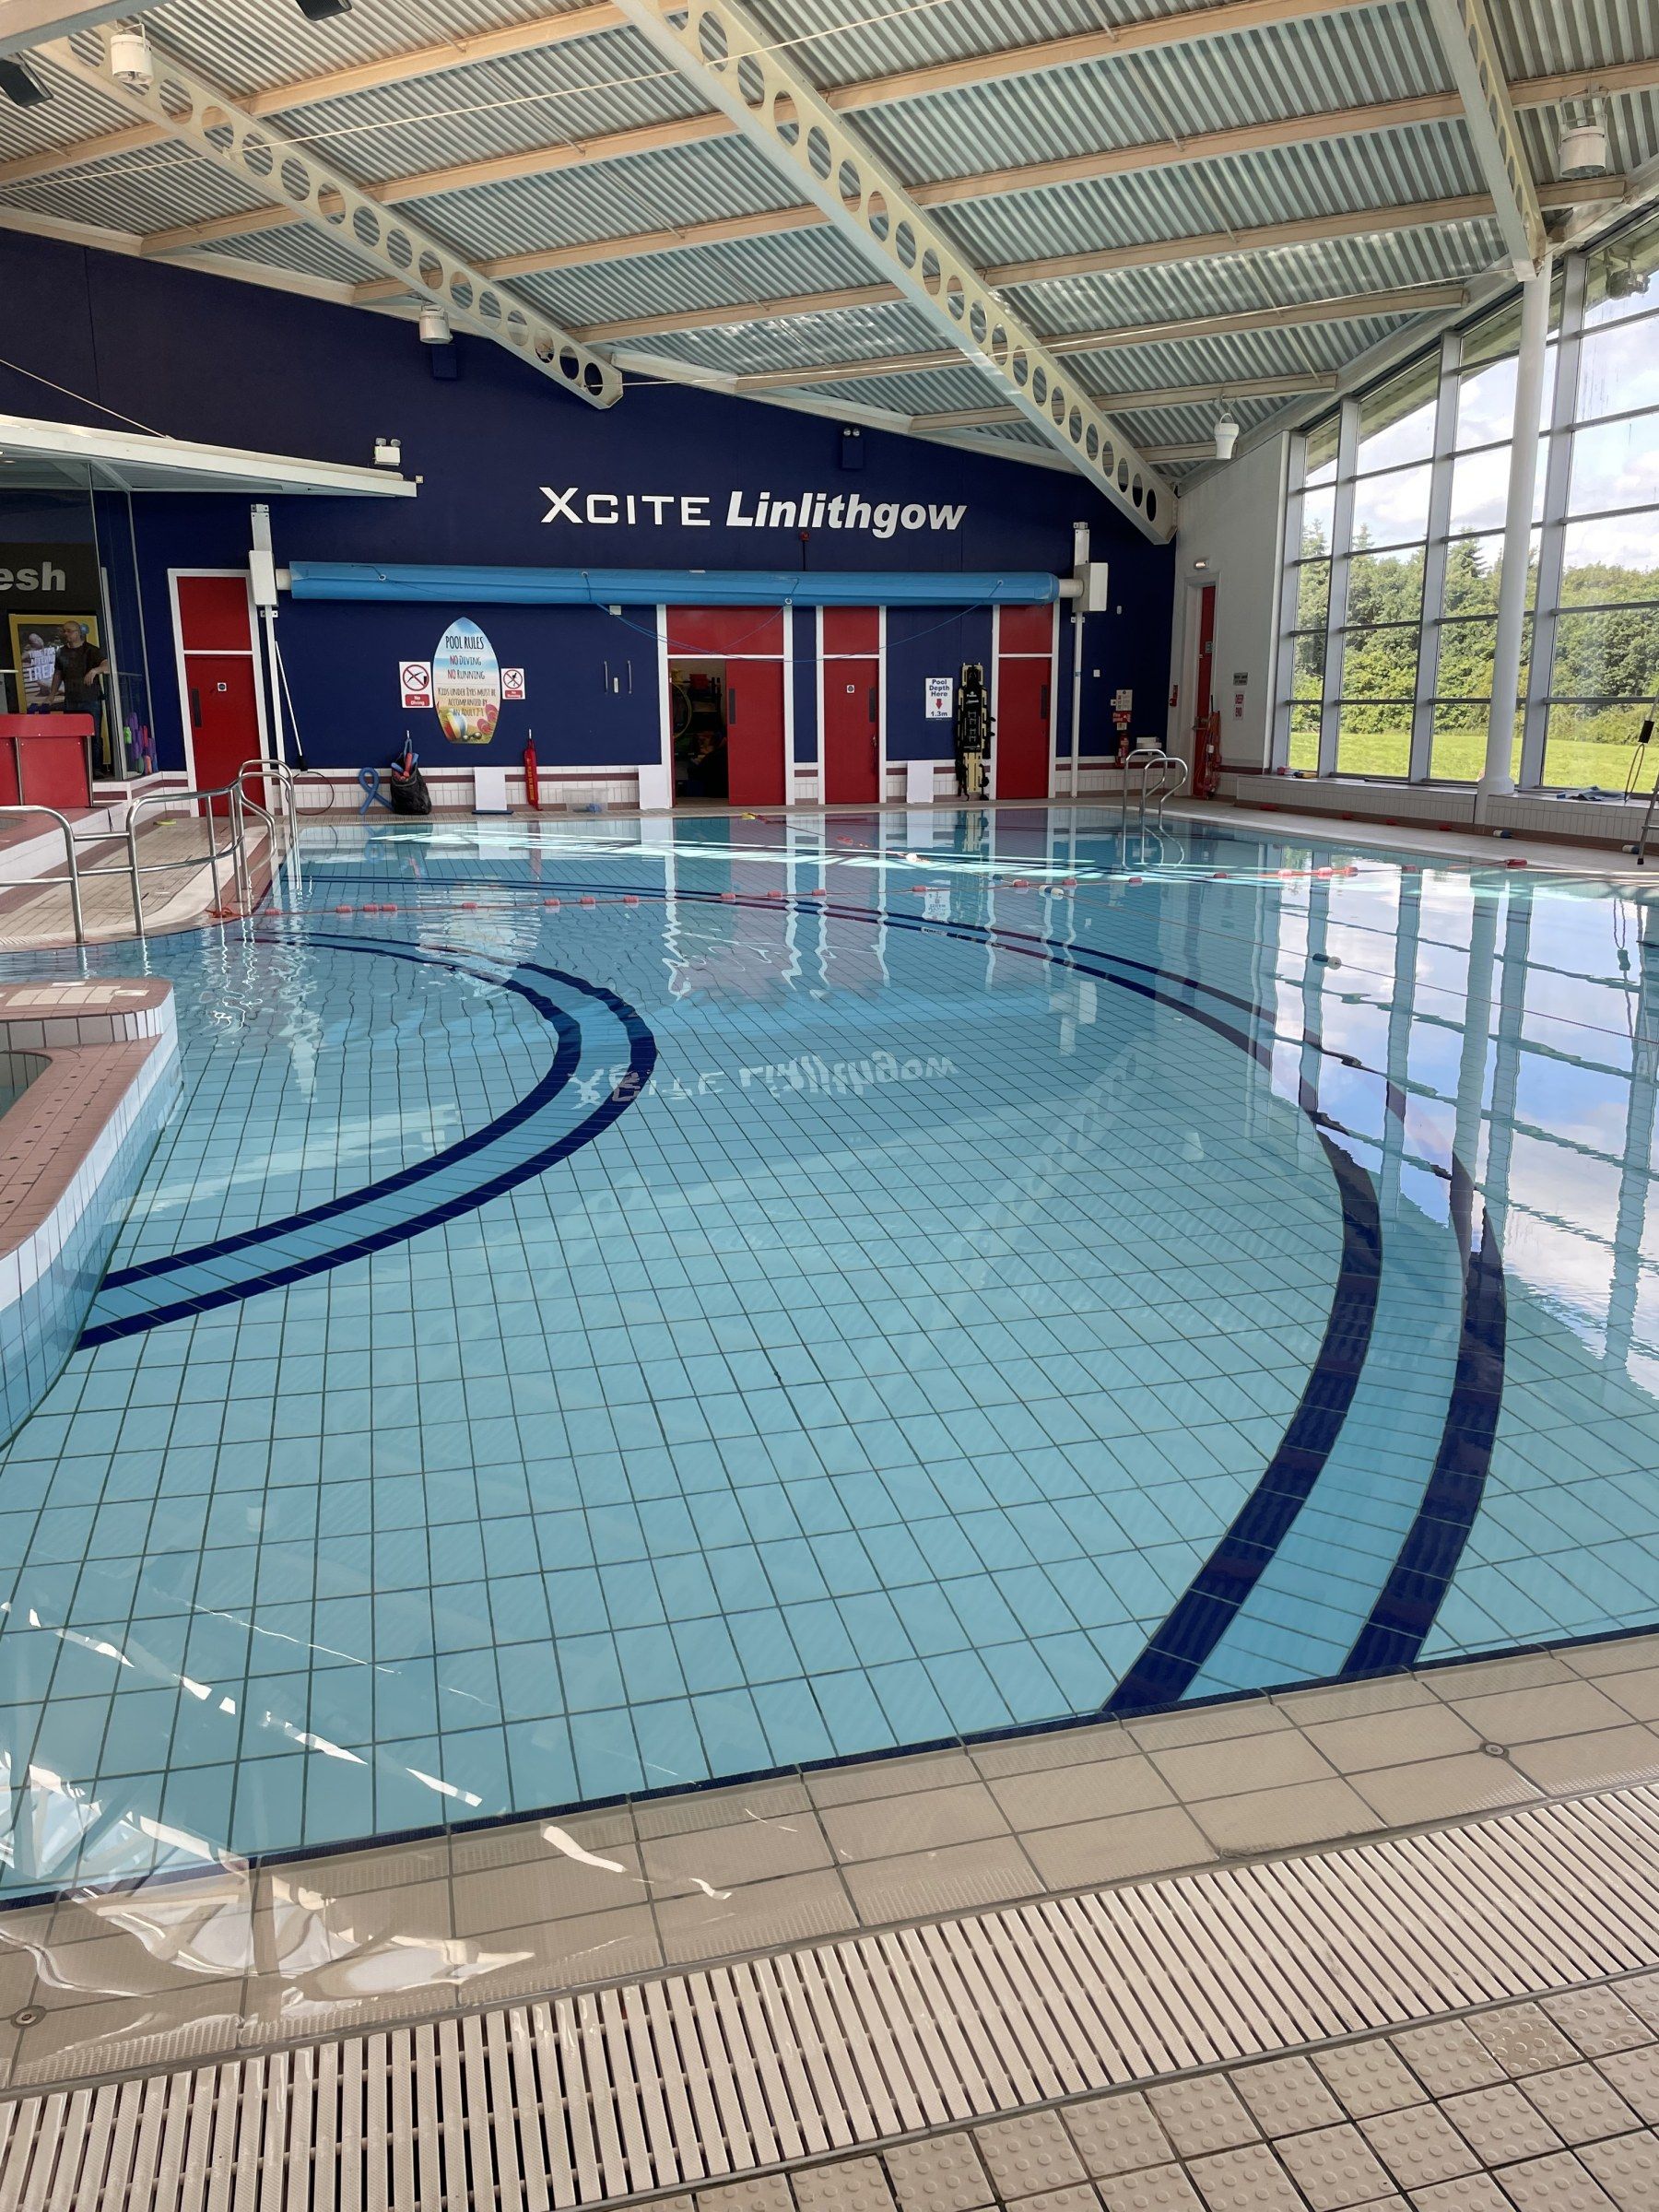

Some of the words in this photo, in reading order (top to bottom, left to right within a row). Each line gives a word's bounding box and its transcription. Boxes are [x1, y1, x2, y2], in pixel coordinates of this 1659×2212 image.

[539, 487, 712, 526] XCITE
[725, 491, 968, 538] Linlithgow
[445, 635, 463, 650] POOL
[464, 636, 485, 650] RULES
[450, 654, 458, 665] NO
[447, 669, 456, 680] NO
